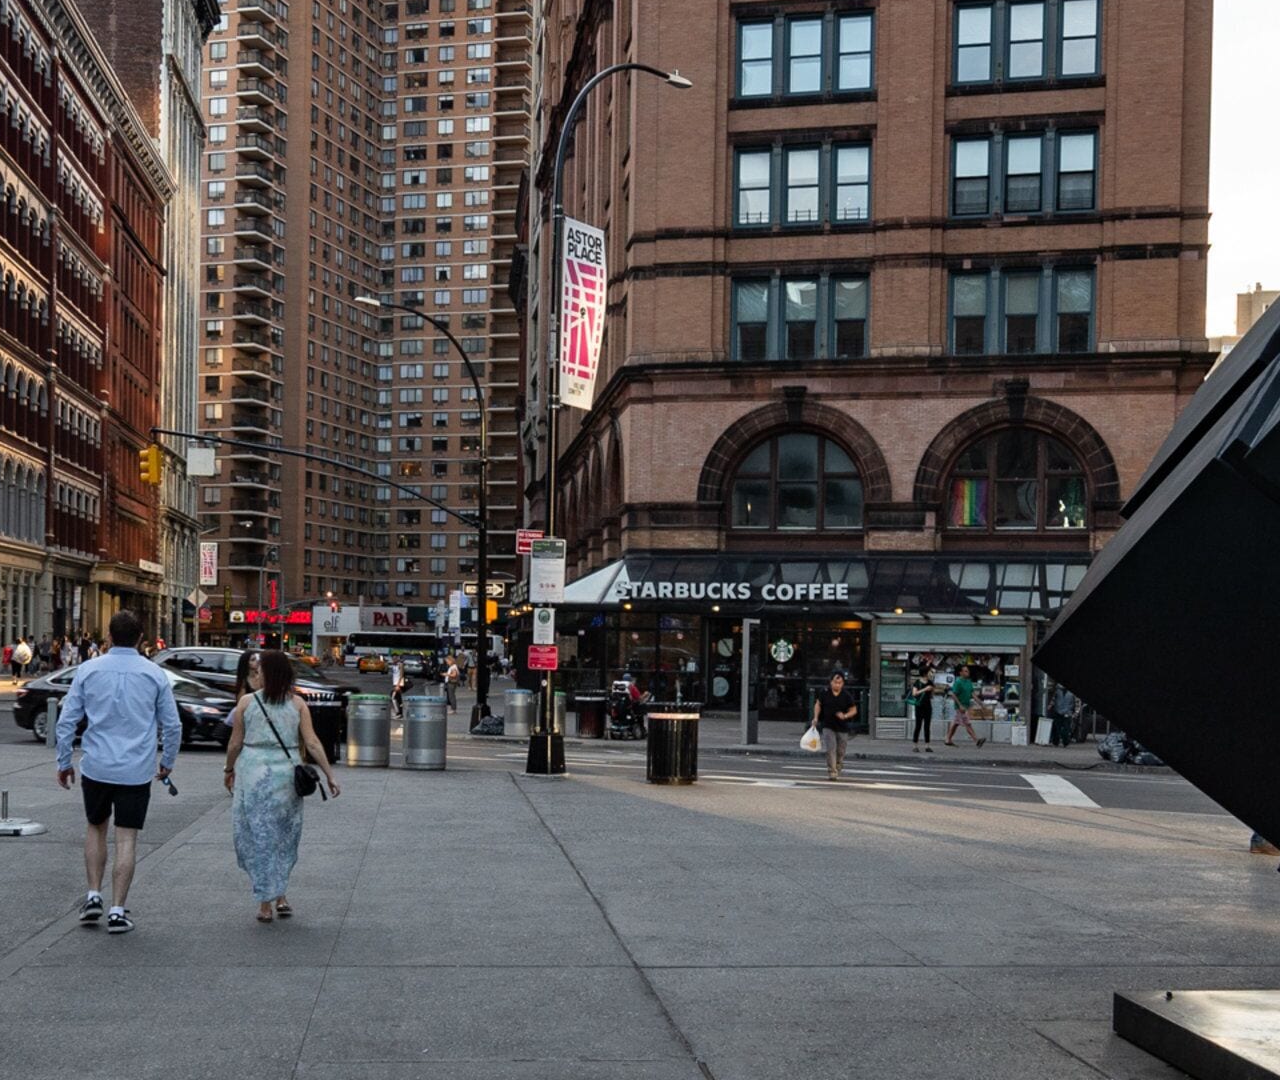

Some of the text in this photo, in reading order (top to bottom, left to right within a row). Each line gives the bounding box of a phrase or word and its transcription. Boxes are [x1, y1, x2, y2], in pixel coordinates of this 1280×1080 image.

[567, 227, 602, 251] ASTOR
[567, 242, 602, 265] PLACE
[615, 580, 849, 601] STARBUCKS COFFEE
